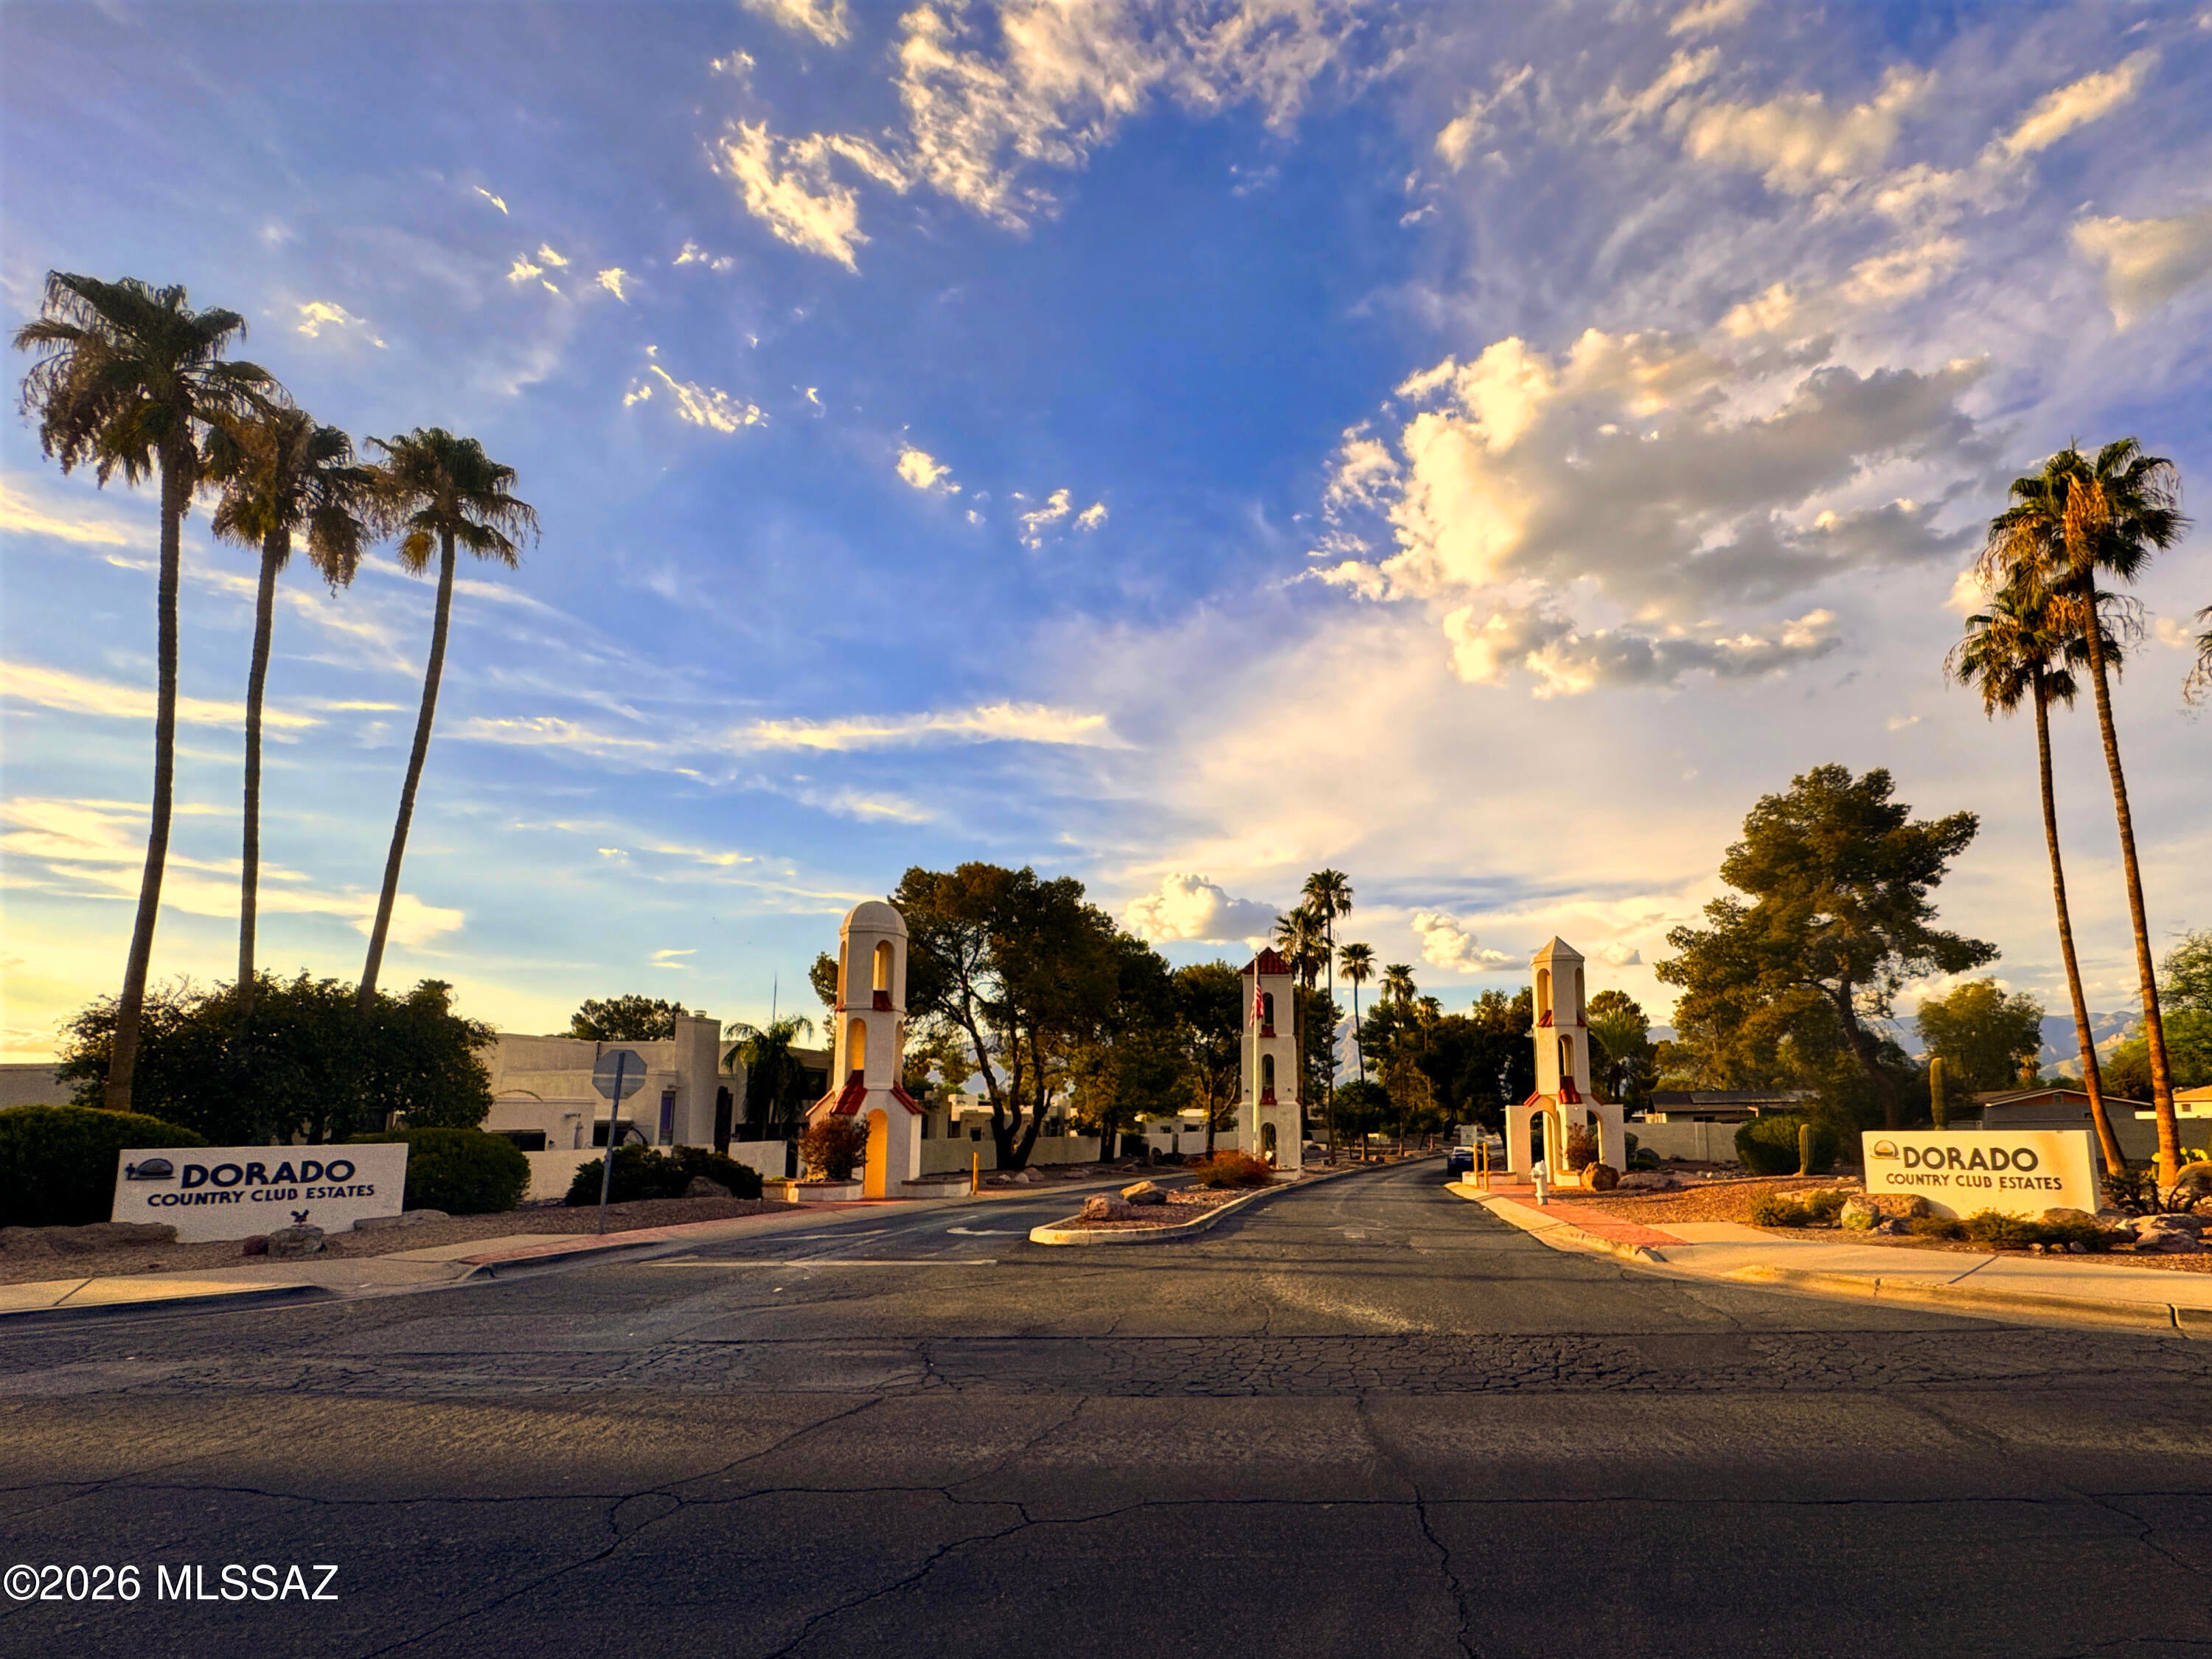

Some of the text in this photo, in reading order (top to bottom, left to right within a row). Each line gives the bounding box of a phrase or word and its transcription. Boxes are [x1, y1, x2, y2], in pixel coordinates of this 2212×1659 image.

[1903, 1147, 2039, 1172] DORADO
[181, 1159, 356, 1189] DORADO
[1886, 1173, 2062, 1190] COUNTRY CLUB ESTATES
[148, 1183, 375, 1207] COUNTRY CLUB ESTATES
